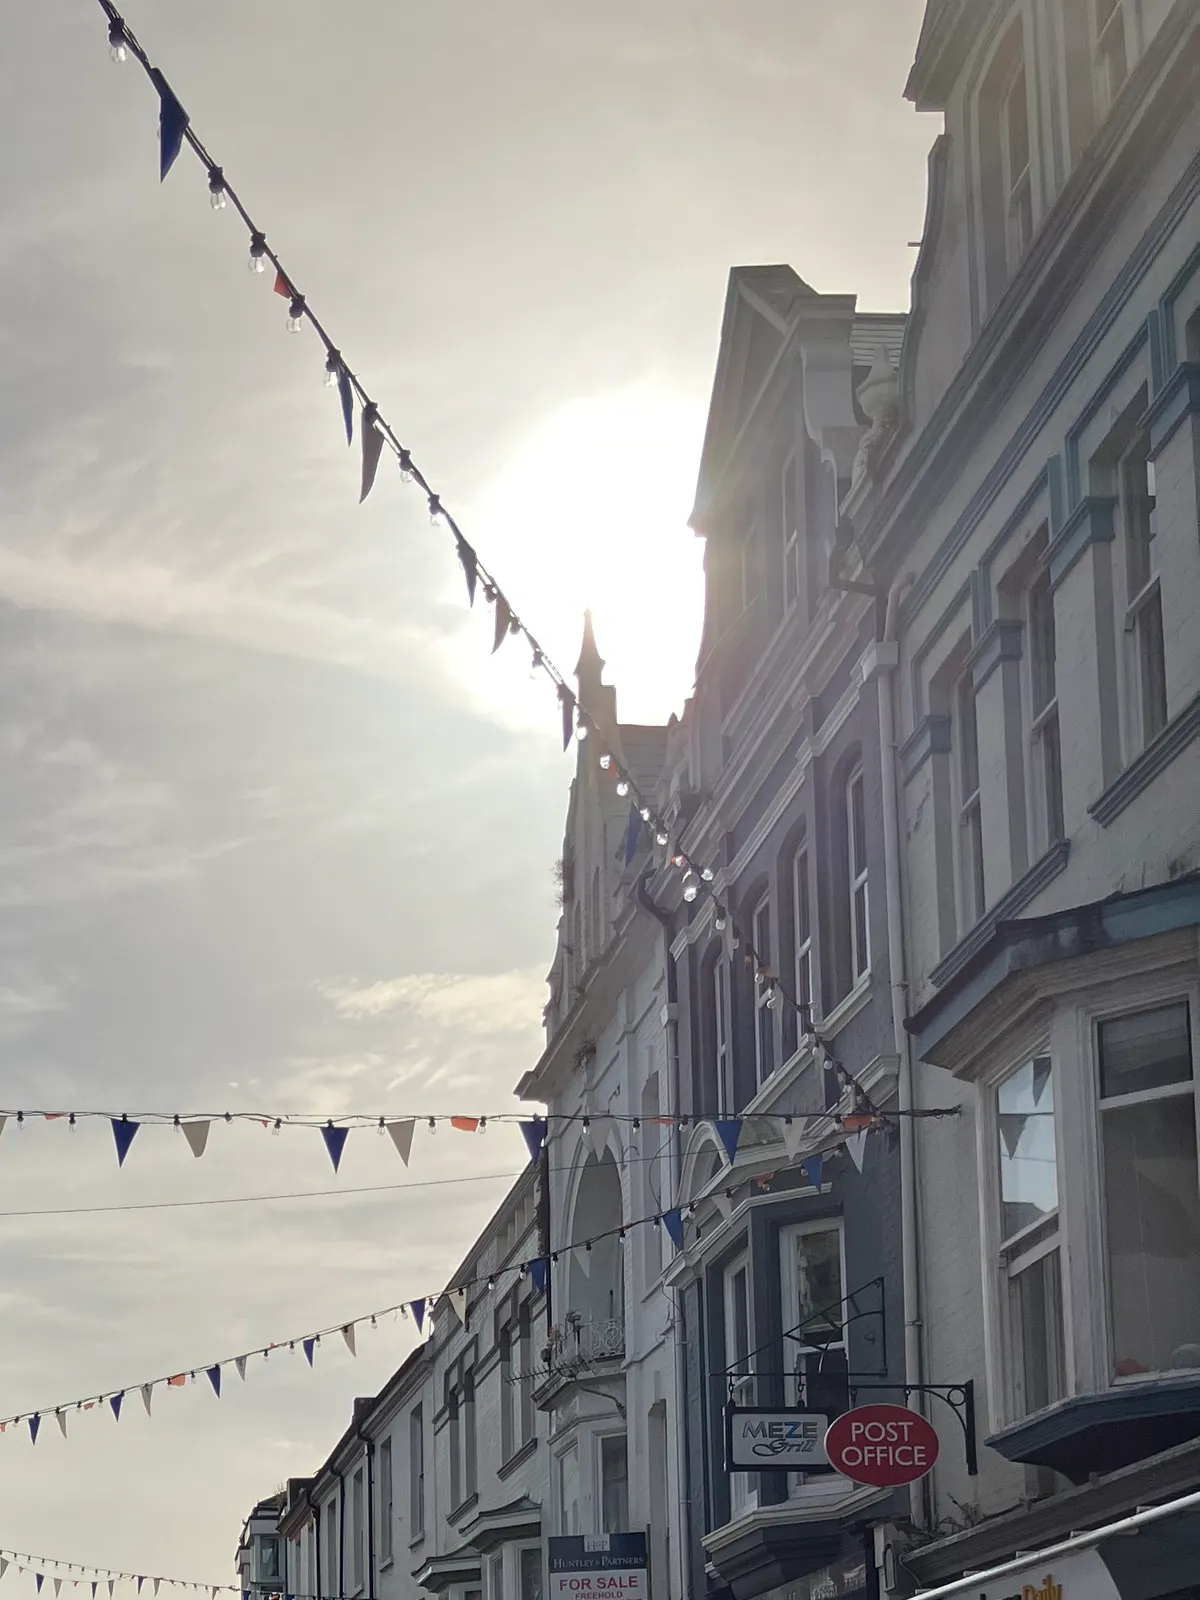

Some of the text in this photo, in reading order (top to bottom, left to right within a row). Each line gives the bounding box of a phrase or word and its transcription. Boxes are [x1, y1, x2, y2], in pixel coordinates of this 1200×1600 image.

[742, 1421, 818, 1439] MEZE
[851, 1421, 914, 1442] POST
[751, 1439, 817, 1457] Grill
[841, 1446, 927, 1466] OFFICE
[553, 1558, 595, 1569] HUNTLEY
[601, 1556, 644, 1567] PARTNERS
[560, 1576, 638, 1591] FOR SALE
[575, 1591, 623, 1600] FREEHOLD
